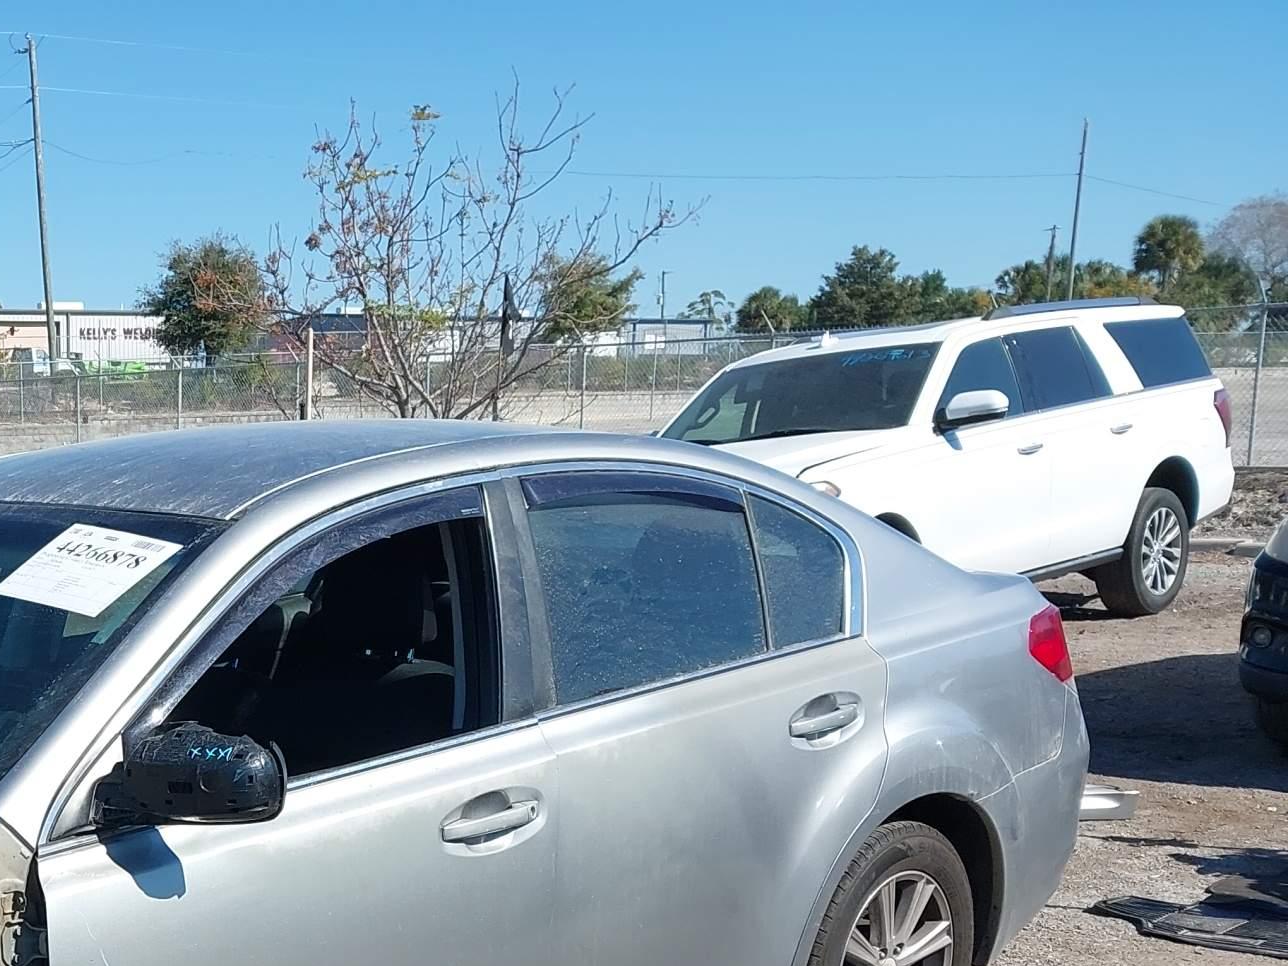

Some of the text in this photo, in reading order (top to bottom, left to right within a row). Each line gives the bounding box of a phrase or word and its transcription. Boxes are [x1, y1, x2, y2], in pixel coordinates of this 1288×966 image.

[79, 327, 156, 341] KELLY'S WELDI
[56, 539, 147, 570] 44266878
